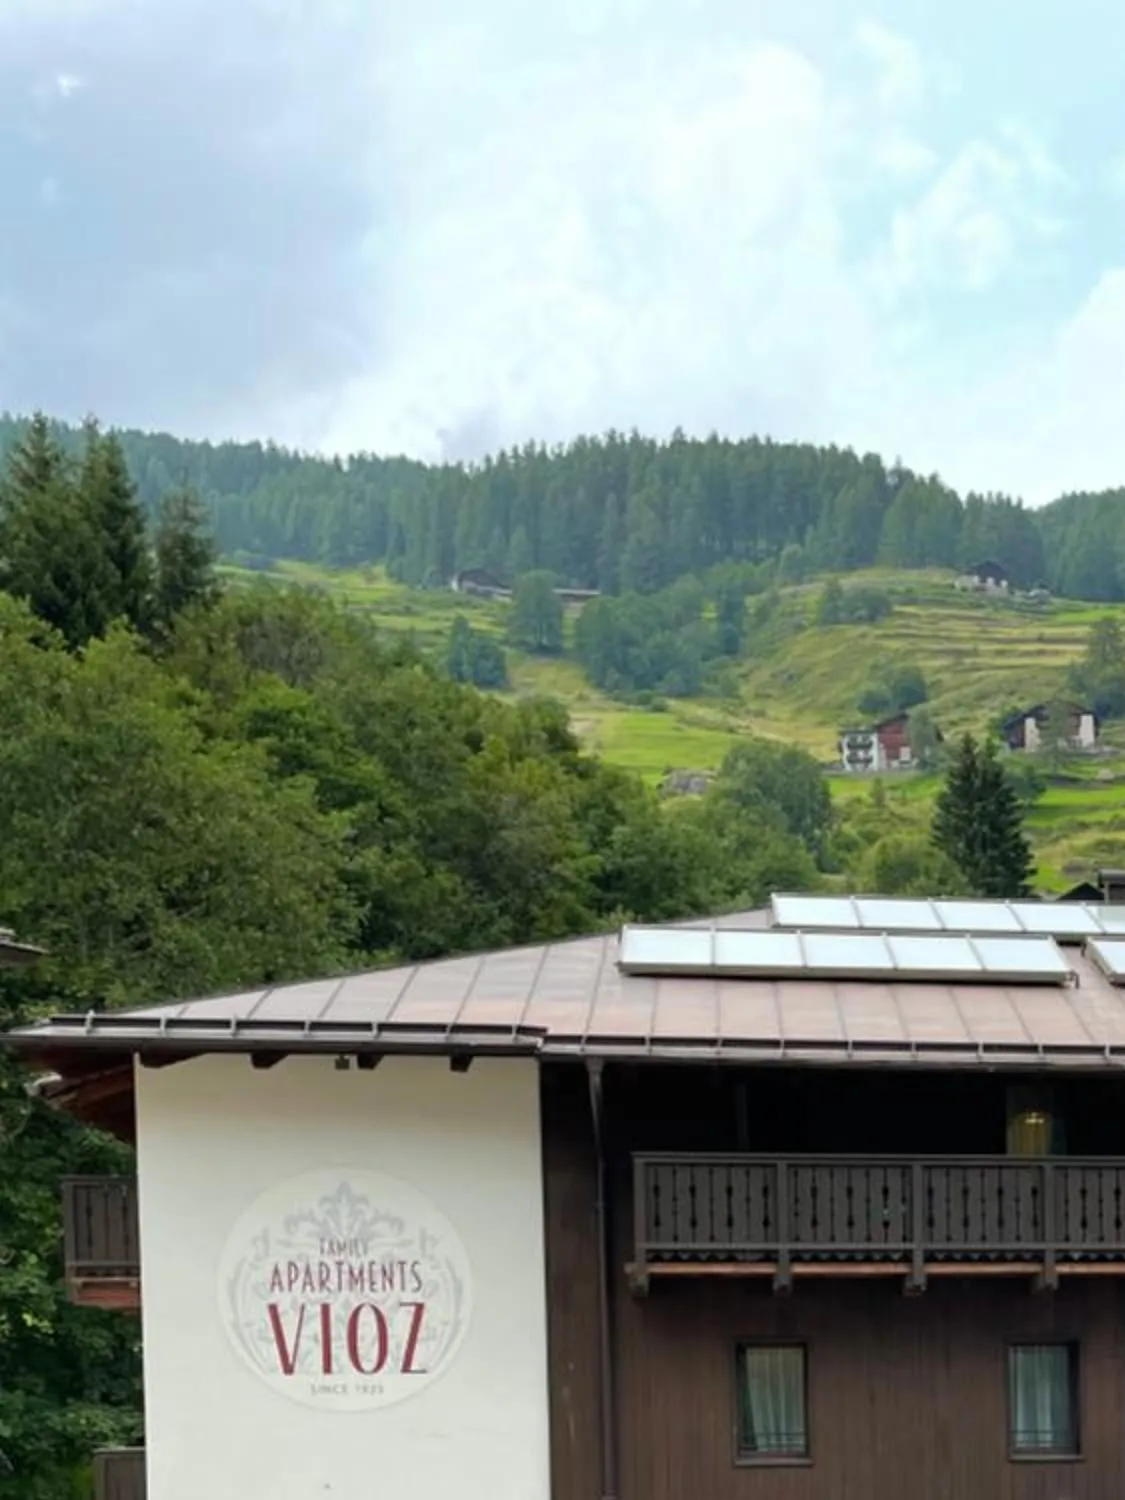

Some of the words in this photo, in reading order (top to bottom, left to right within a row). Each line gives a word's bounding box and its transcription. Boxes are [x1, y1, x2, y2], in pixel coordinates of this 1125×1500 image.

[318, 1238, 370, 1256] FAMILY
[269, 1260, 423, 1293] APARTMENTS
[267, 1302, 428, 1376] VIOZ
[310, 1383, 348, 1396] SINCE
